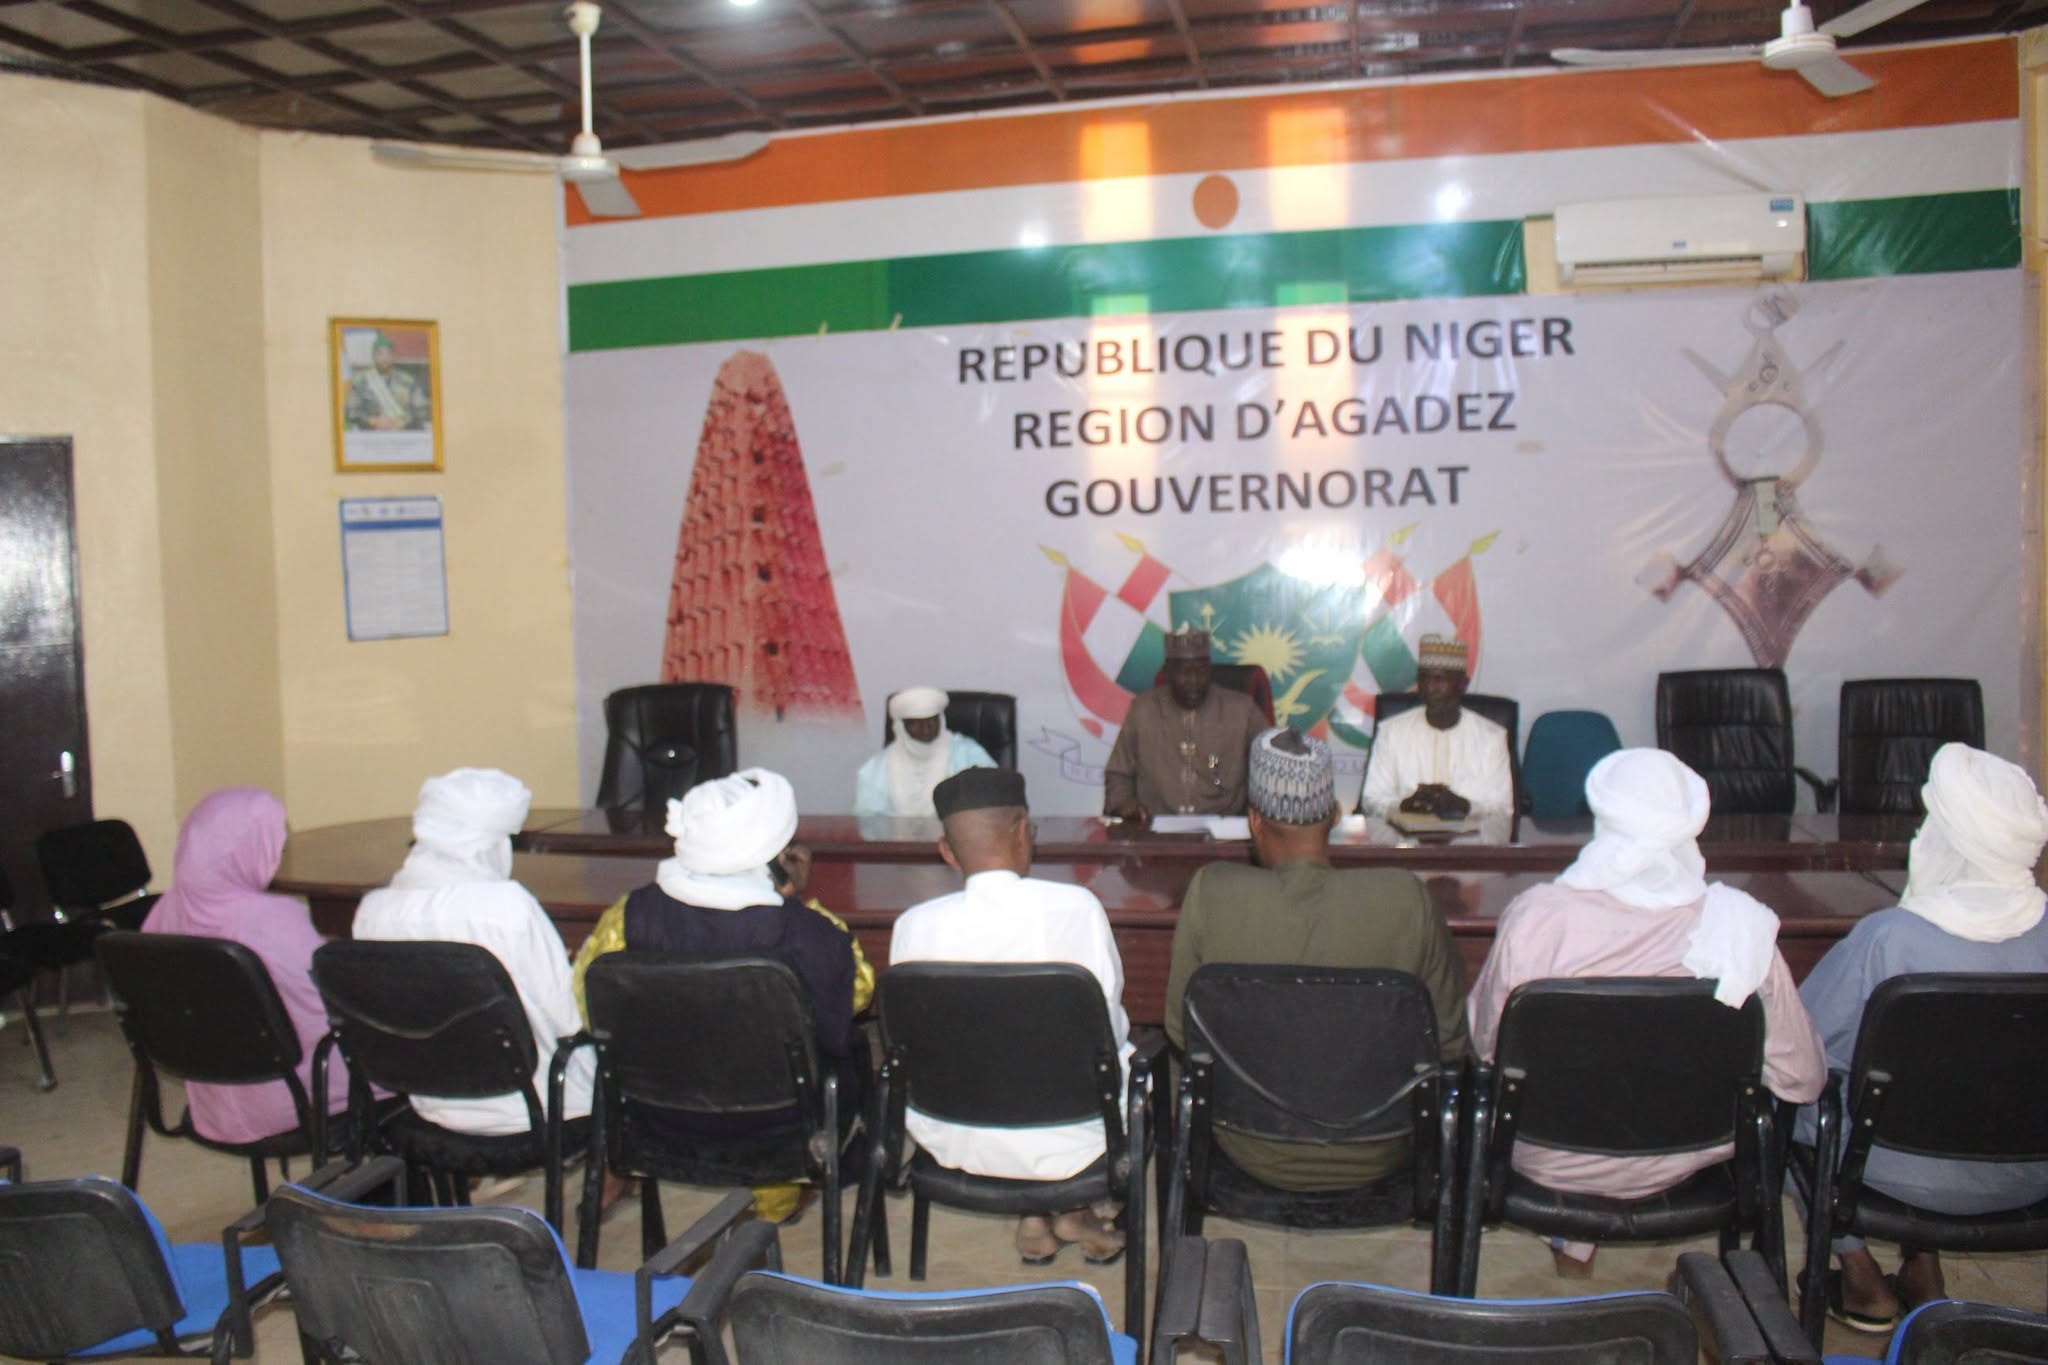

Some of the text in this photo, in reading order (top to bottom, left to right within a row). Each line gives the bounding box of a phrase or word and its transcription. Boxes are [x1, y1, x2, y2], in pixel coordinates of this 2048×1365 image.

[957, 317, 1576, 385] REPUBLIQUE DU NIGER
[1012, 404, 1215, 450] REGION
[1043, 465, 1471, 519] GOUVERNORAT
